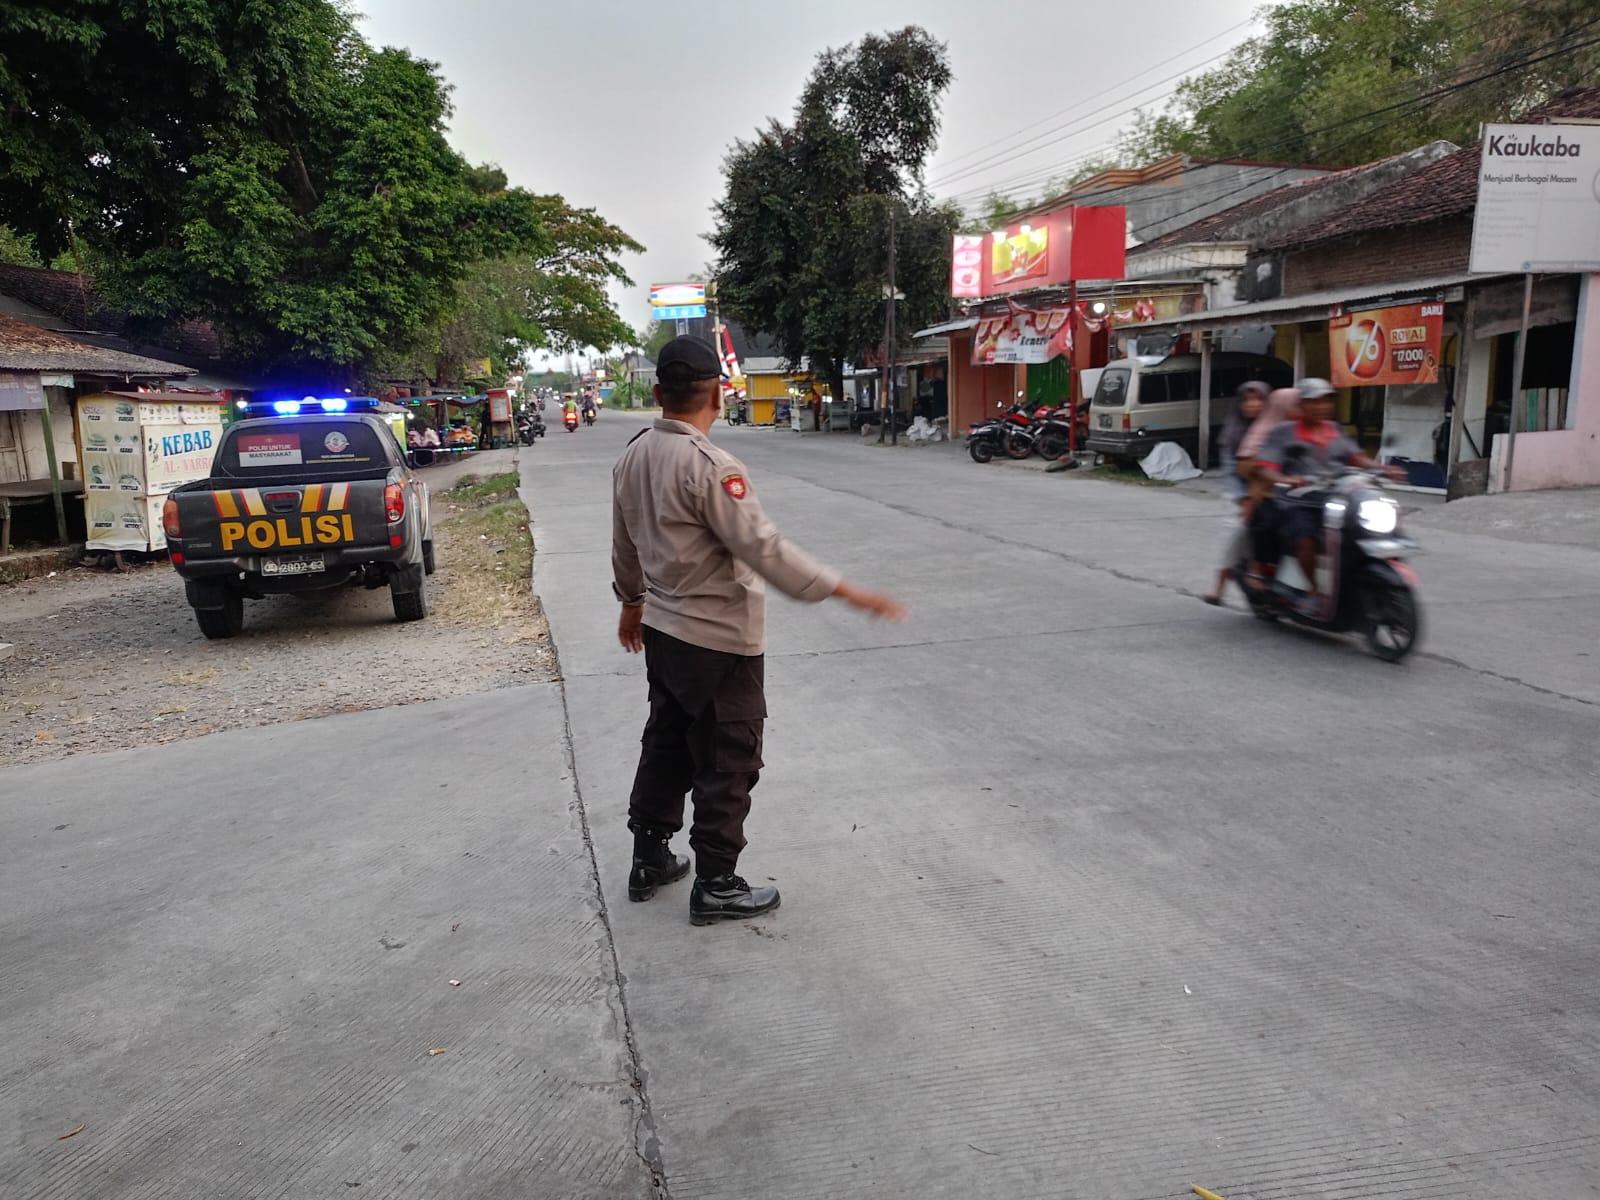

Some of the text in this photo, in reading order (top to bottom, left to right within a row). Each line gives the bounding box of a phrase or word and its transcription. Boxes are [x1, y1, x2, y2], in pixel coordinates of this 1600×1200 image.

[1488, 134, 1581, 157] Kaukaba
[1483, 174, 1577, 184] Menjual Berbagai Macam
[1391, 327, 1424, 343] ROYAL
[162, 430, 213, 457] KEBAB
[219, 514, 355, 551] POLISI
